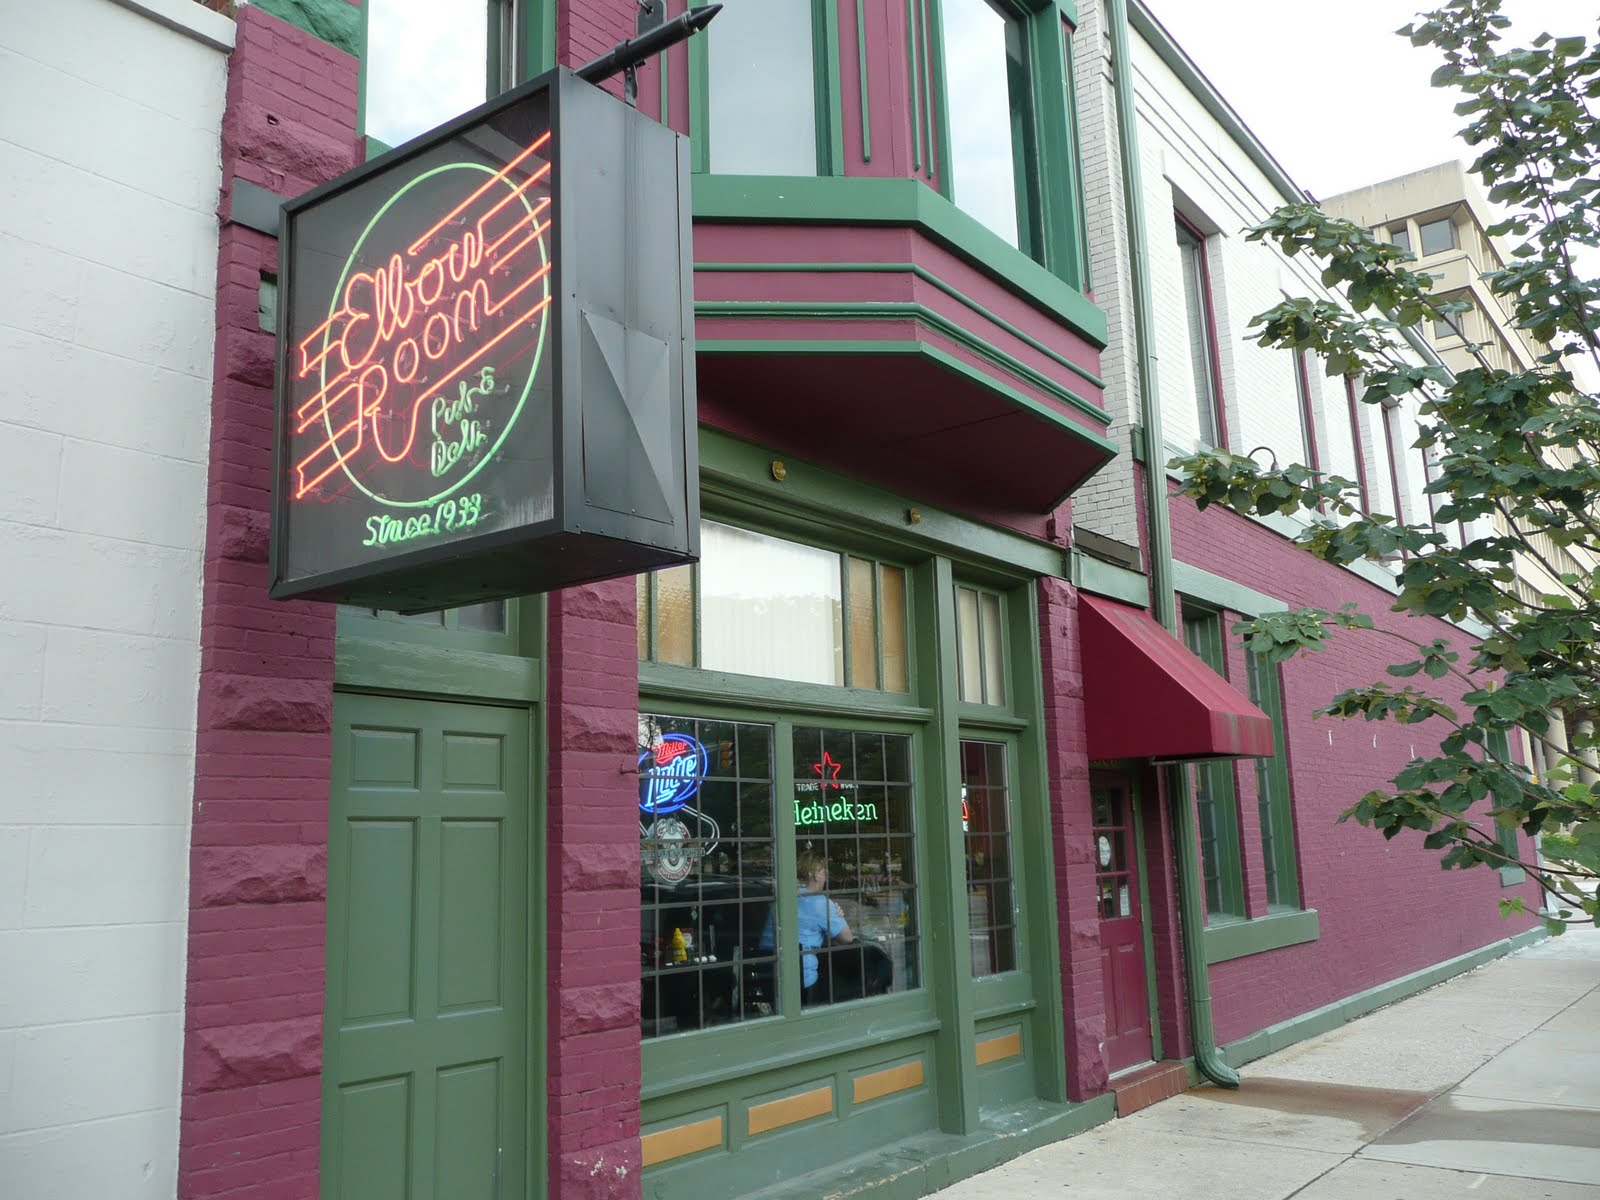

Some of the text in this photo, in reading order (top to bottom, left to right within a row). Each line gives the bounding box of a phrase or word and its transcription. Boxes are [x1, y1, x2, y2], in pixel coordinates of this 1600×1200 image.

[341, 225, 484, 370] Elbow
[353, 277, 490, 463] Room
[431, 418, 488, 477] Deli
[363, 493, 482, 546] Since 1933
[654, 741, 688, 759] Miller
[795, 782, 819, 792] TRADE
